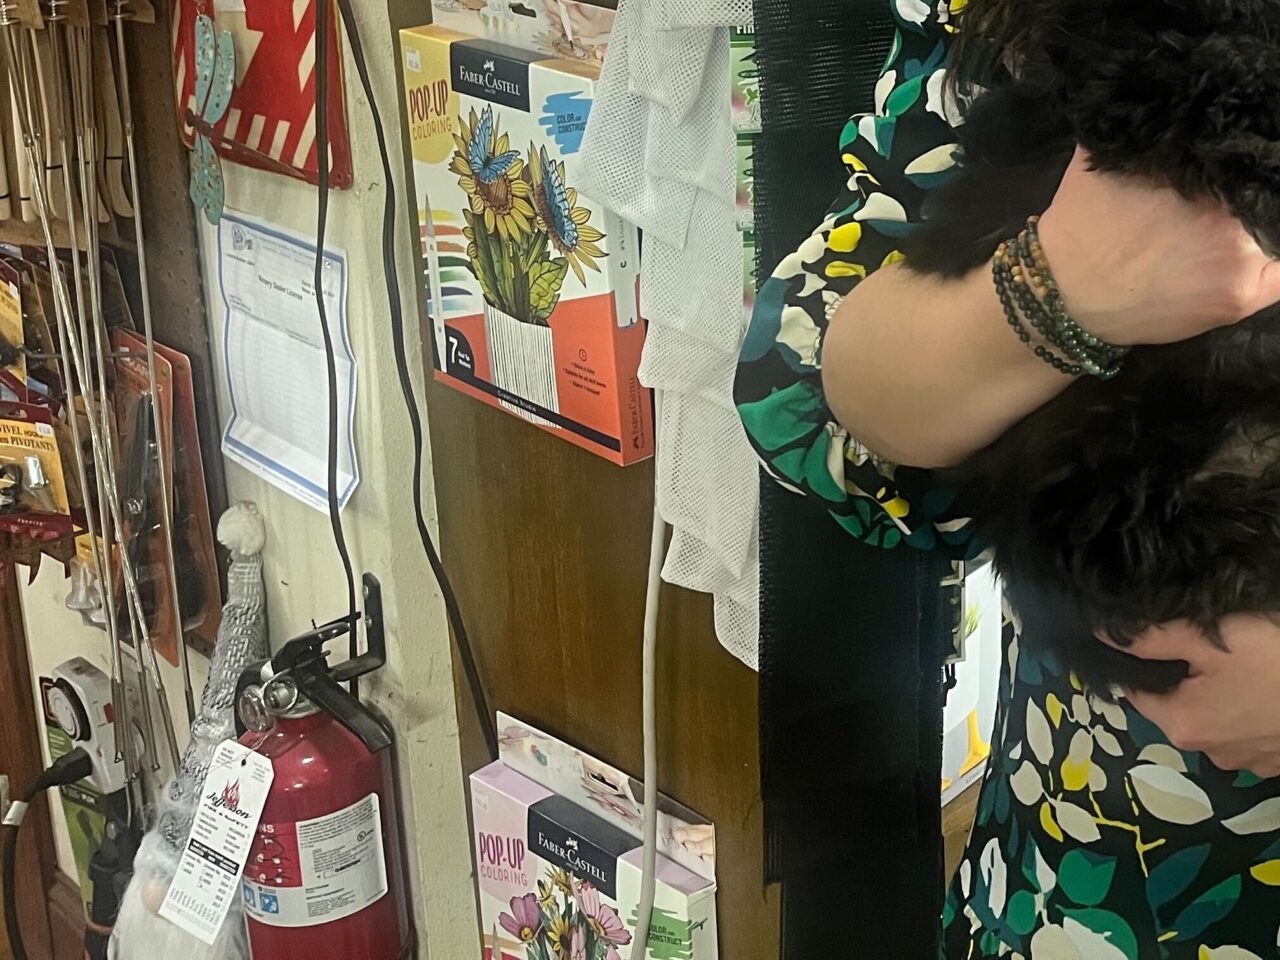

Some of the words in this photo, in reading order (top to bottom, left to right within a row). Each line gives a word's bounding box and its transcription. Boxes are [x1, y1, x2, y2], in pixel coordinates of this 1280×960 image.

[459, 65, 521, 96] FABER-CASTELL
[409, 79, 448, 125] POP-UP
[412, 116, 452, 141] COLORING
[556, 113, 574, 124] COLOR
[448, 336, 458, 364] 7
[206, 792, 252, 819] Jefferson
[479, 831, 526, 870] POP-UP
[538, 831, 608, 883] FABER-CASTELL
[481, 865, 528, 887] COLORING
